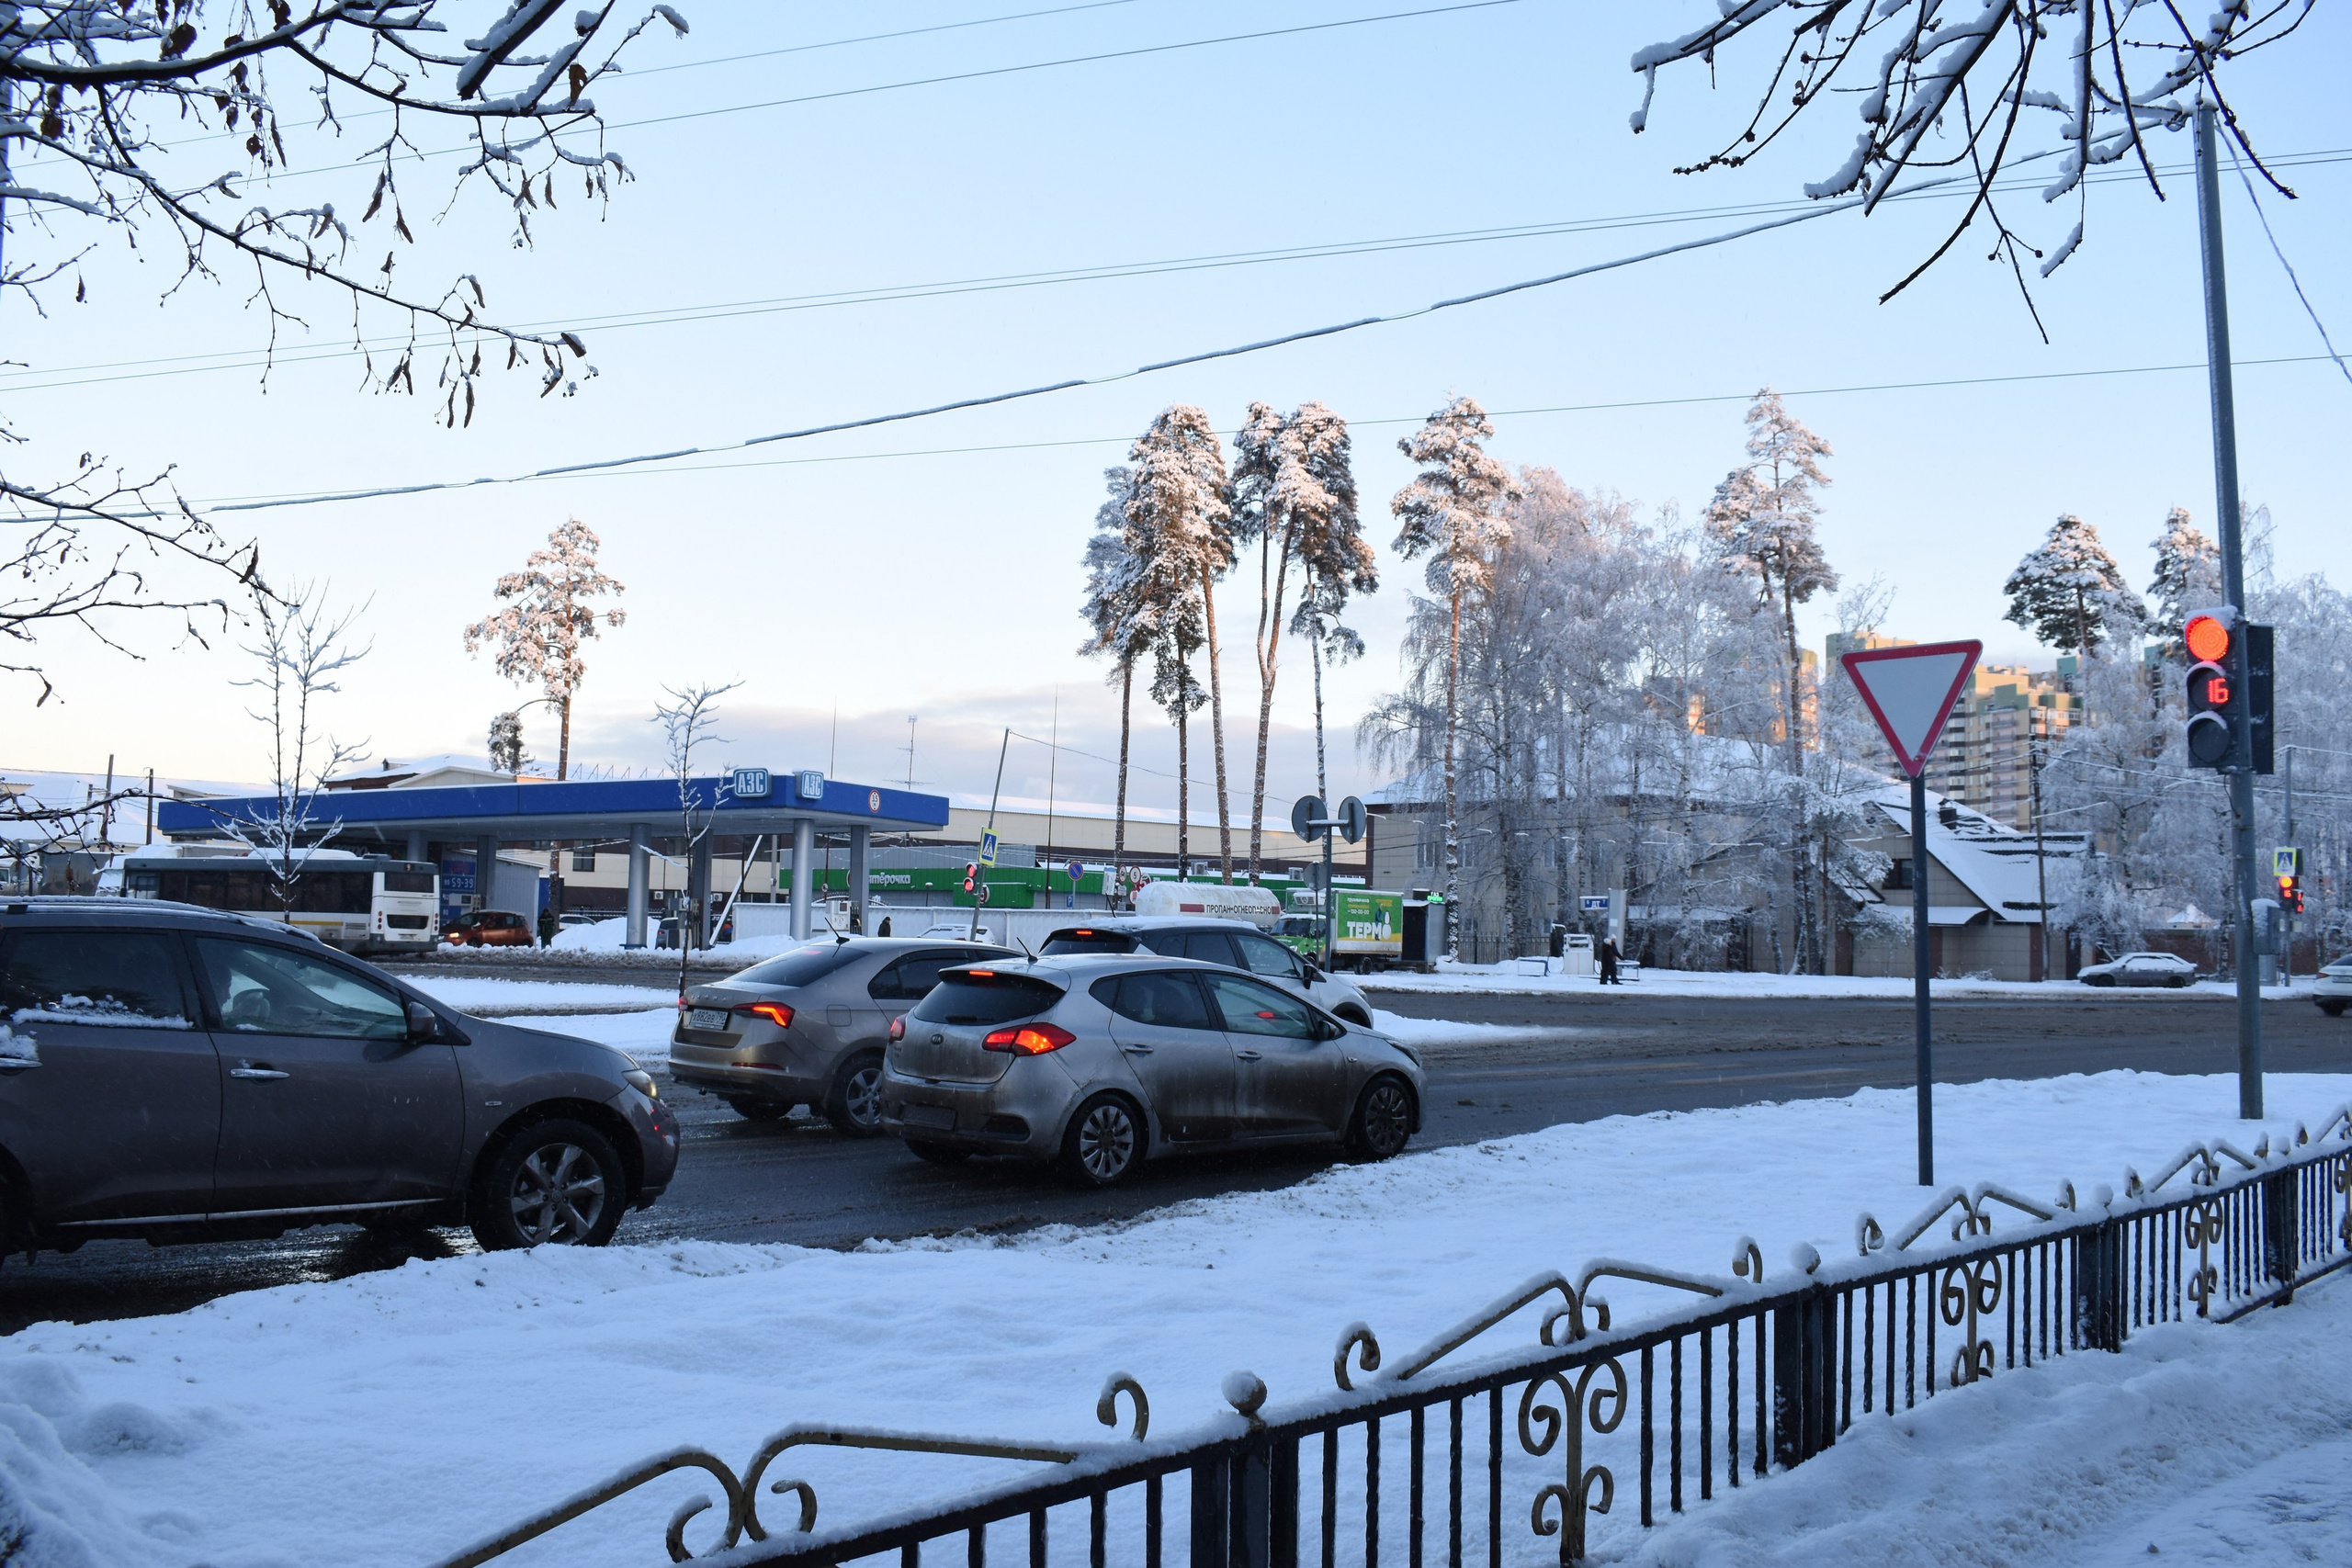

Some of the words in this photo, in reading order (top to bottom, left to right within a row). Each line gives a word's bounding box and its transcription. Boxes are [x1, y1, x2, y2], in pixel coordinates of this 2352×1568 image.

[2208, 678, 2228, 704] 16
[738, 772, 764, 793] АЗС
[804, 774, 820, 795] АЗС
[1206, 905, 1272, 915] ПРОПАН-ОГНЕОПАСНО
